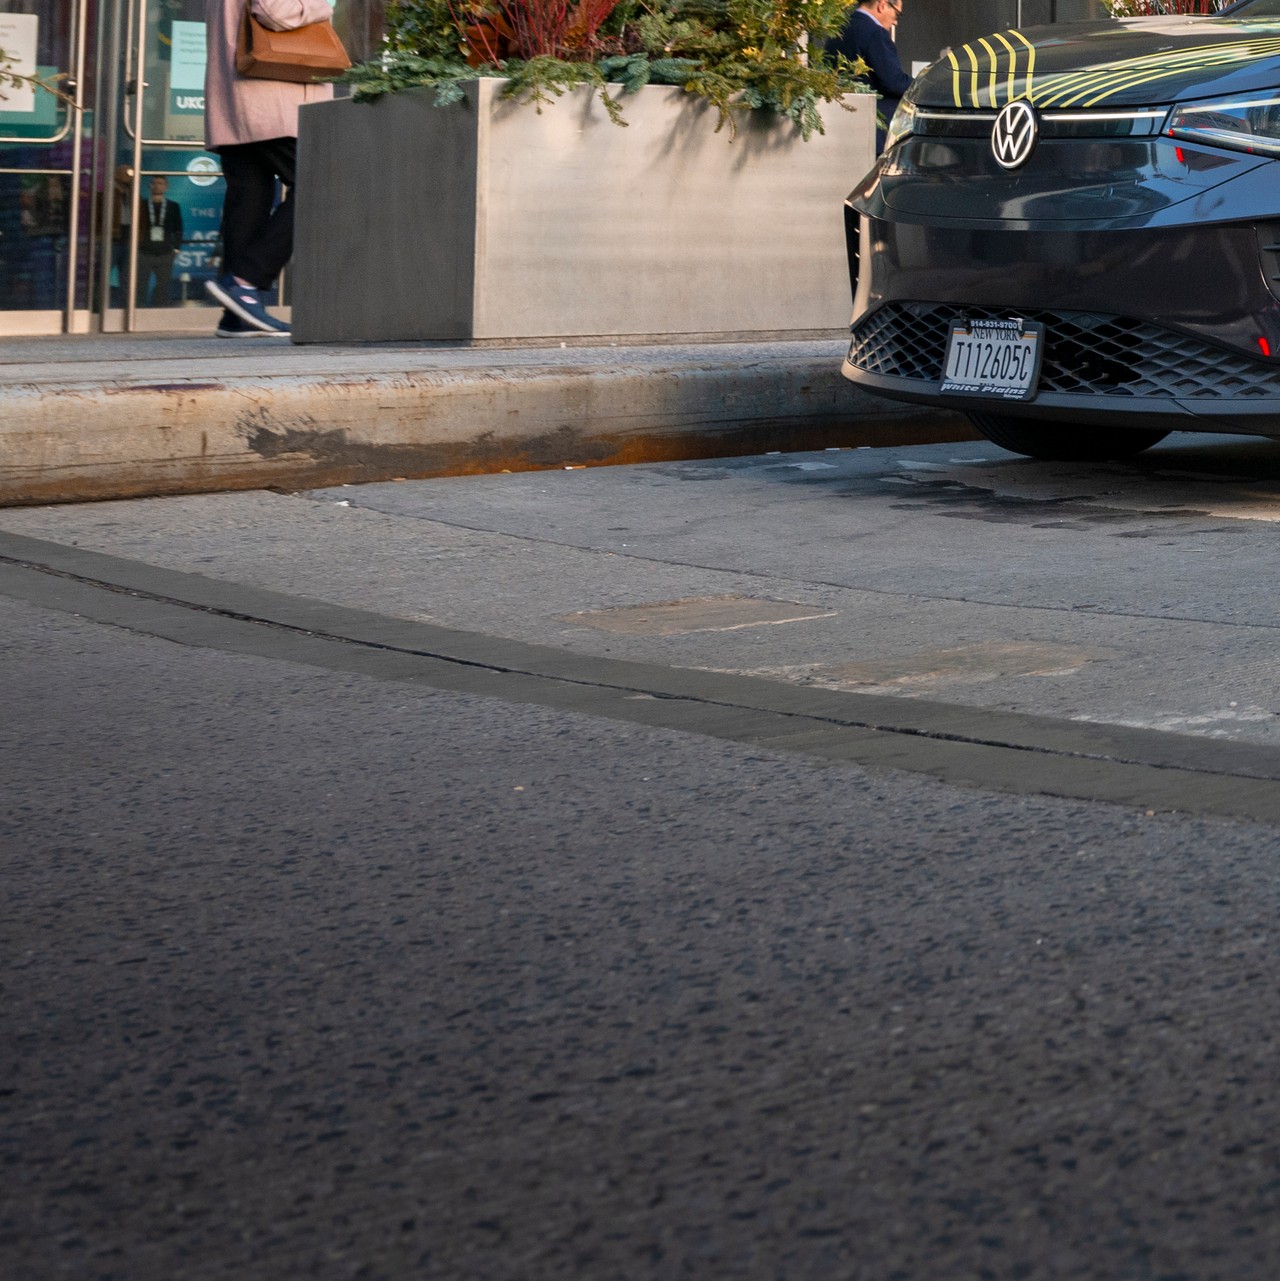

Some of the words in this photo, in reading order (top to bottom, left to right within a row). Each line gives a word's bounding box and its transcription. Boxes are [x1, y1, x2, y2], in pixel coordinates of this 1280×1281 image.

[970, 320, 1018, 329] 914-931-9700
[973, 328, 992, 340] NEW
[995, 329, 1018, 341] YORK
[954, 341, 1031, 382] T112605C
[940, 383, 979, 392] White
[981, 385, 1027, 395] Plains
